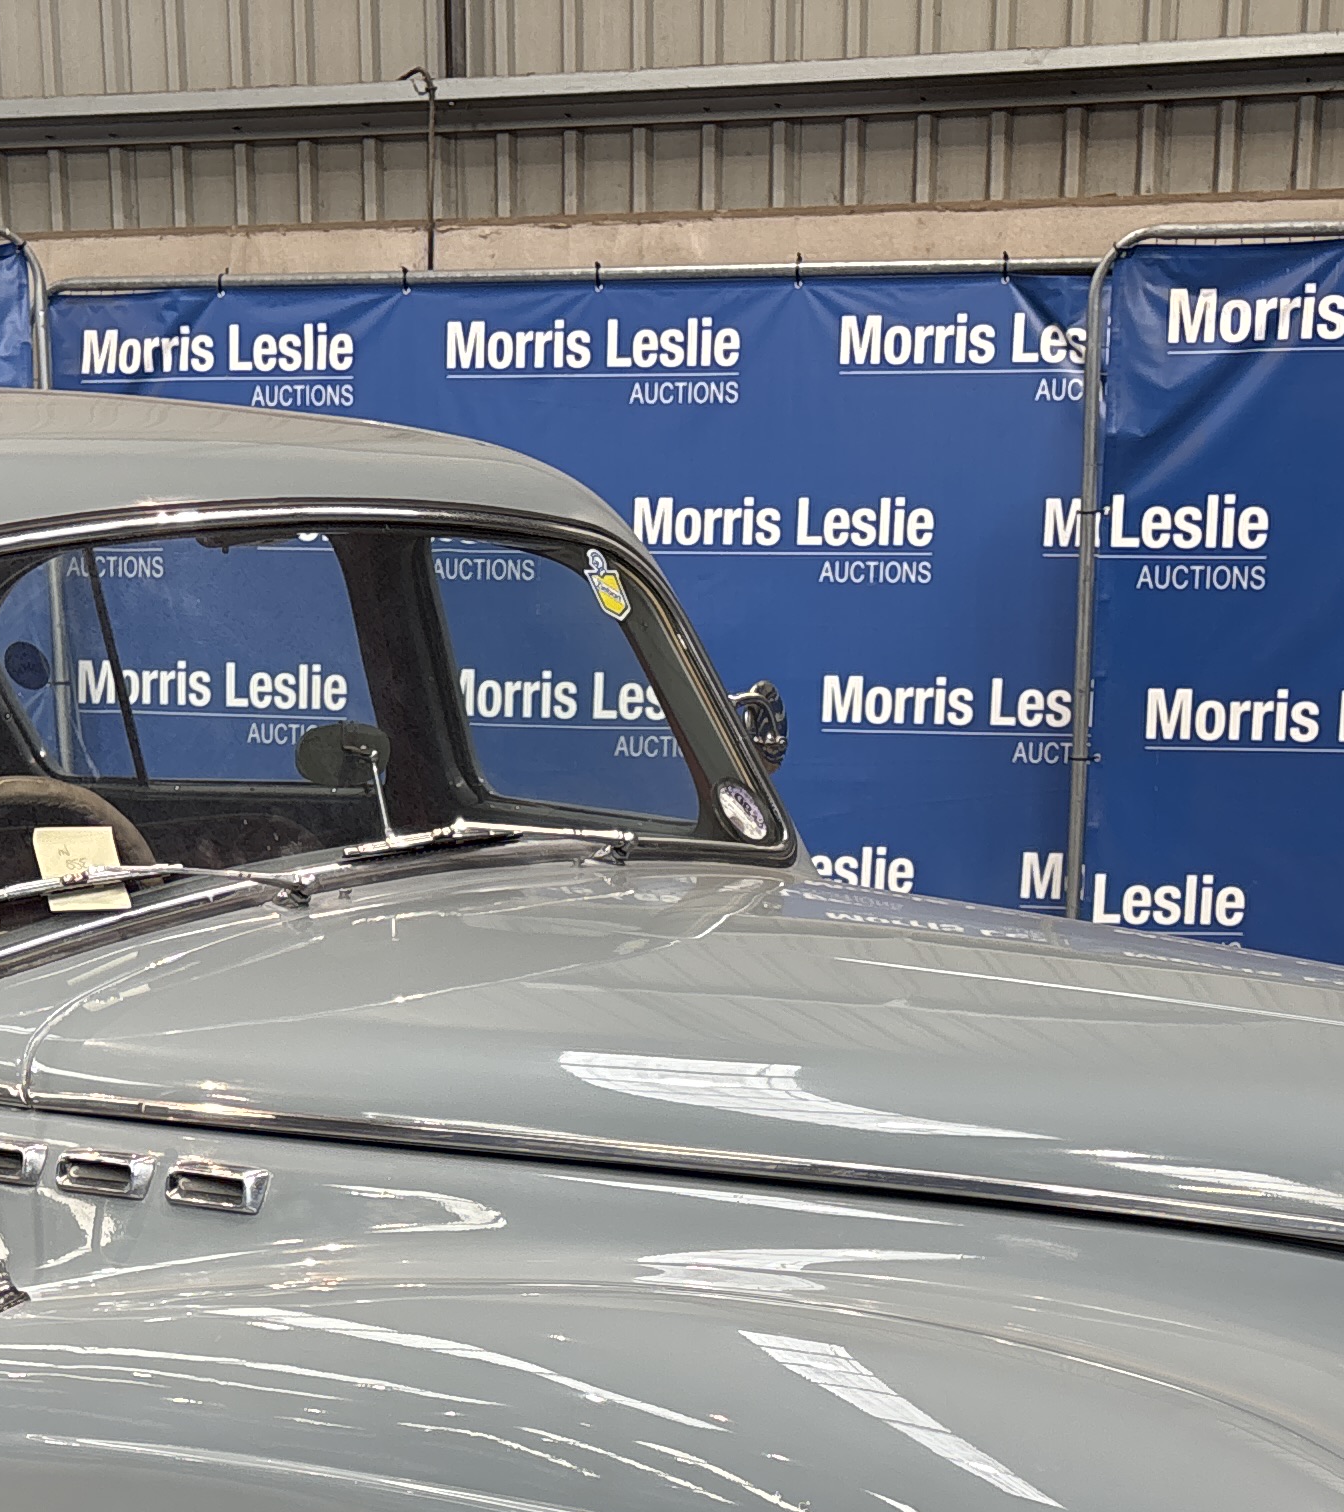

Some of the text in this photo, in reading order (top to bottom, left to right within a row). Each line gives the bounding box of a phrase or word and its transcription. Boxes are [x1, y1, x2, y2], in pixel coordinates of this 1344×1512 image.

[82, 323, 353, 374] Morris Leslie
[447, 317, 740, 369] Morris Leslie
[840, 313, 1086, 364] Morris Les
[252, 385, 353, 406] AUCTIONS
[630, 382, 738, 404] AUCTIONS
[634, 497, 934, 546] Morris Leslie
[1110, 494, 1268, 548] Leslie
[819, 561, 931, 583] AUCTIONS
[1137, 565, 1265, 590] AUCTIONS
[79, 660, 346, 710] Morris Leslie
[593, 672, 665, 720] Les
[822, 675, 1071, 727] Morris Les
[247, 723, 317, 744] AUCTI
[1146, 688, 1319, 744] Morris
[615, 736, 683, 757] AUCTI
[1012, 742, 1073, 763] AUCT
[813, 847, 914, 892] eslie
[1093, 874, 1245, 926] Leslie
